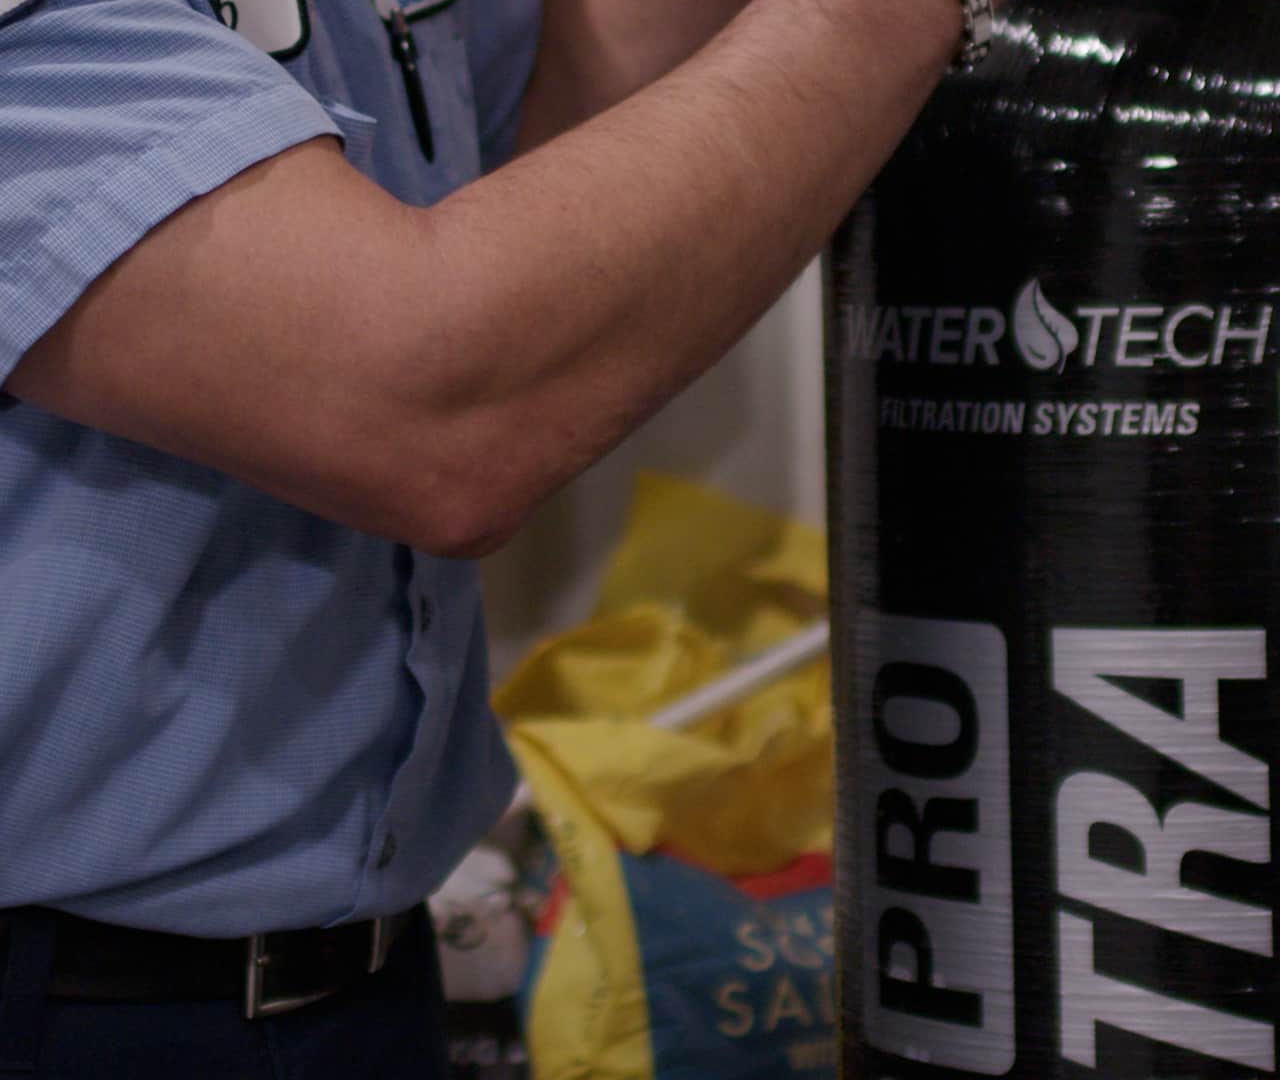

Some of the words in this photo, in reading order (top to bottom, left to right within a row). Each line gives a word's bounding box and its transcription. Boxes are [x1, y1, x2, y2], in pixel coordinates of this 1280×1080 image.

[846, 304, 1006, 366] WATER
[1077, 305, 1274, 368] TECH
[880, 400, 1026, 436] FILTRATION
[1033, 402, 1201, 437] SYSTEMS
[873, 661, 984, 1029] PRO
[1051, 626, 1275, 1073] TRA
